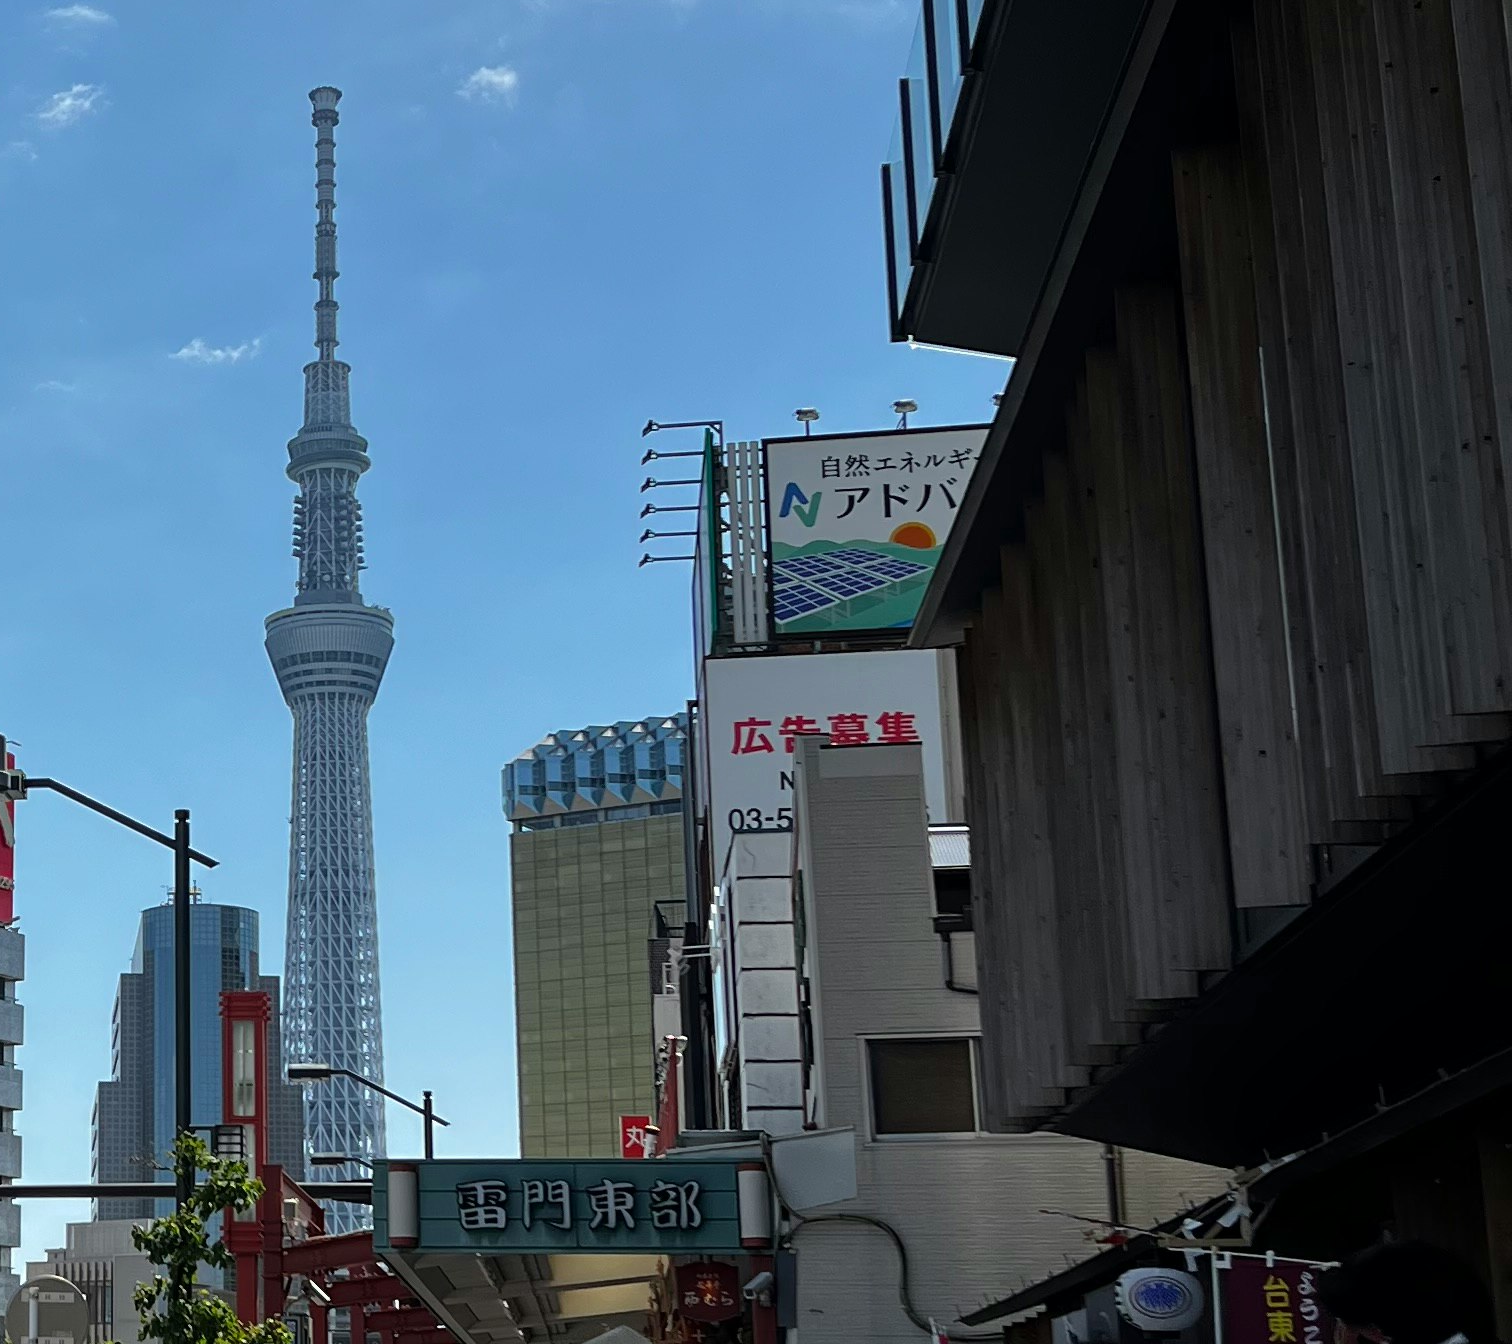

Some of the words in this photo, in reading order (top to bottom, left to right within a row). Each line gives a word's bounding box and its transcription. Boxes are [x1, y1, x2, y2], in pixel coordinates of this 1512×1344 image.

[731, 711, 920, 755] 広告募集
[456, 1177, 703, 1231] 雷門東部
